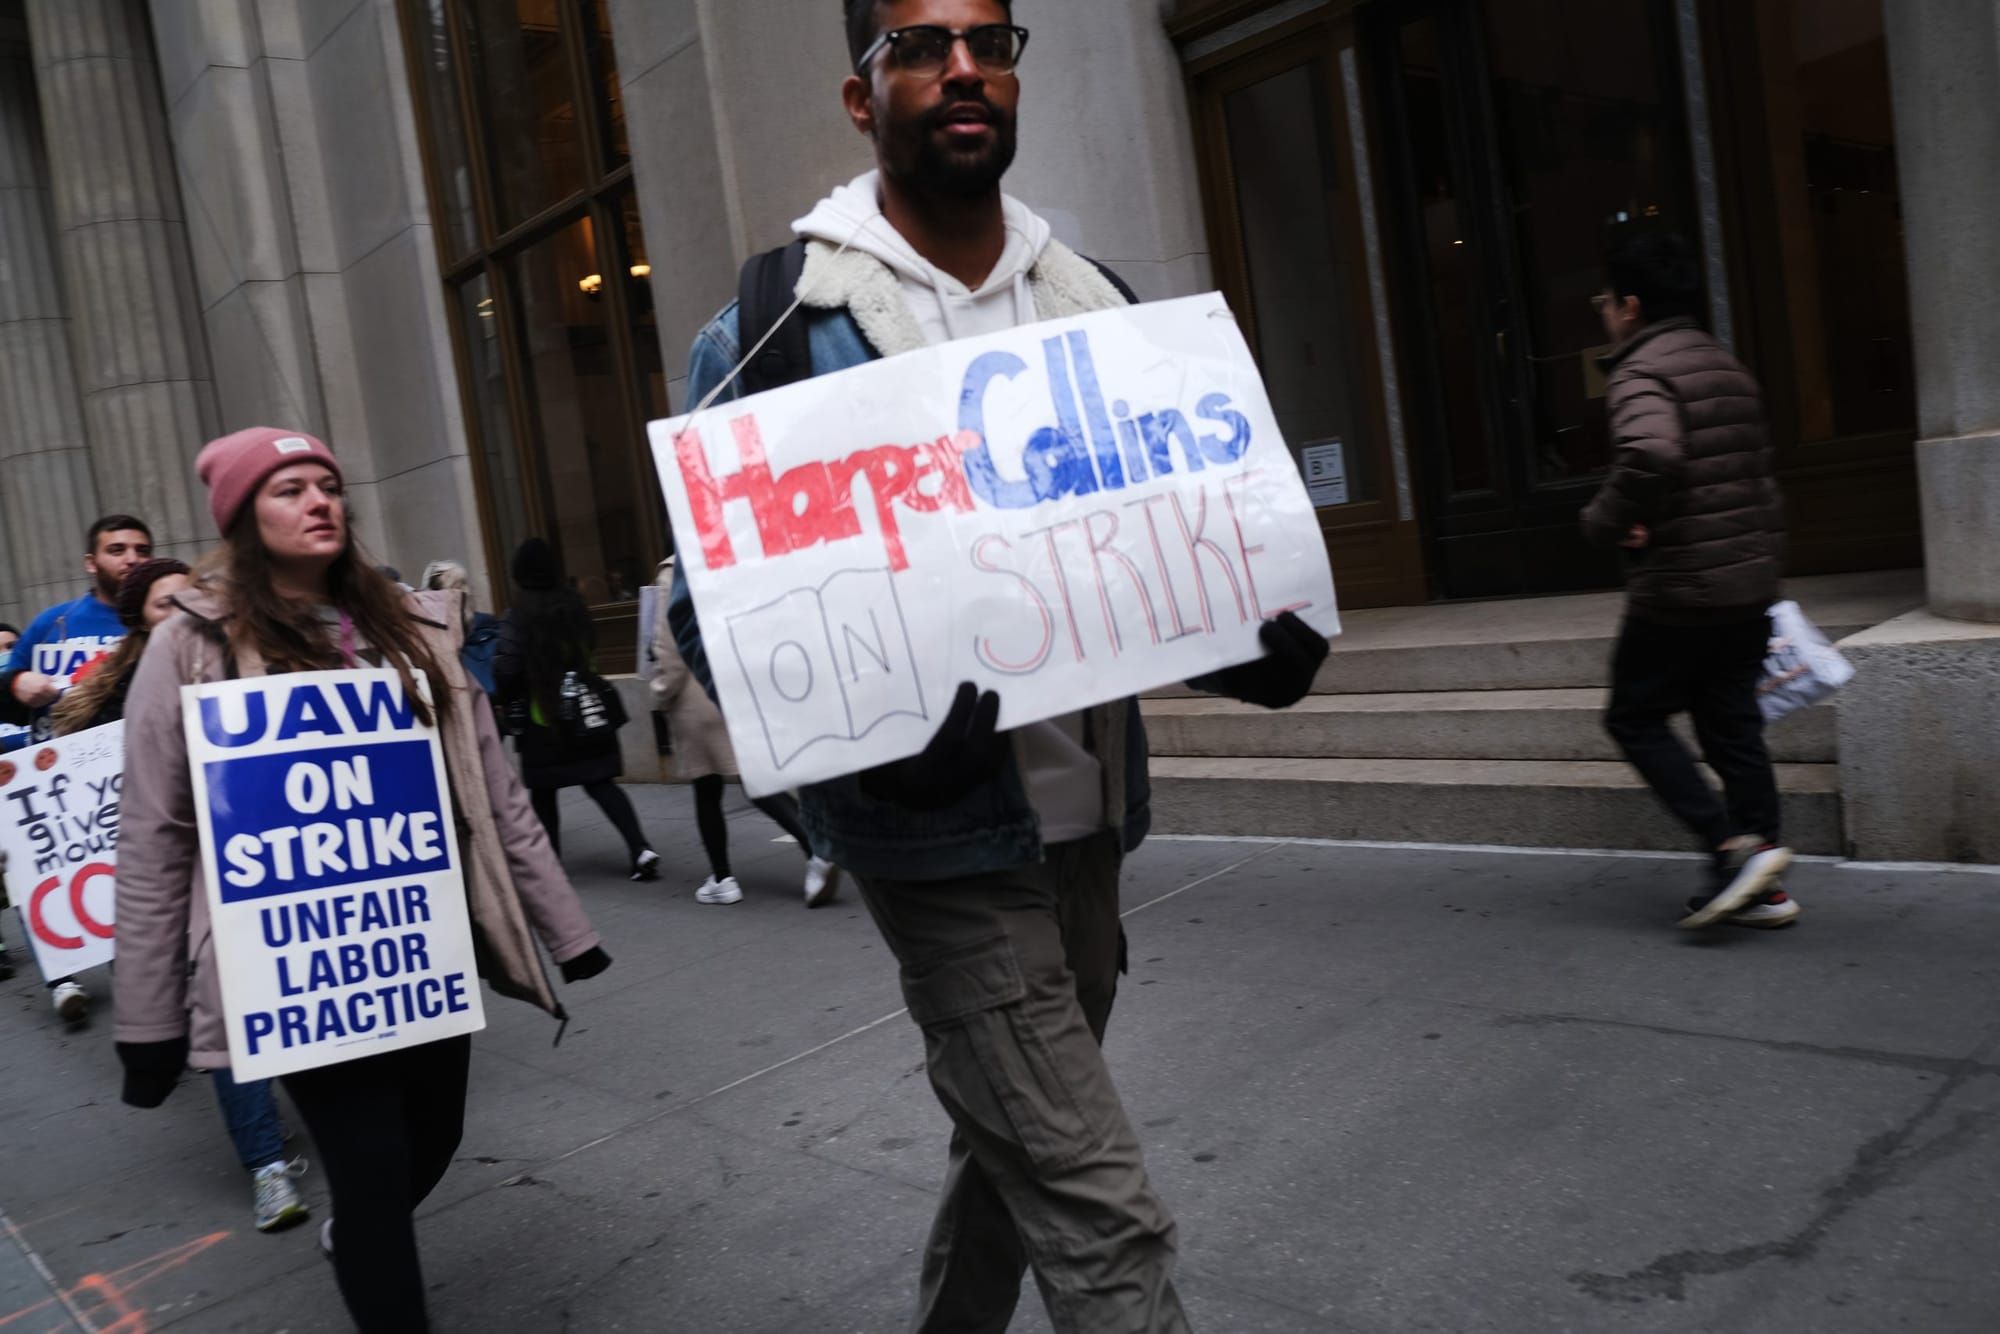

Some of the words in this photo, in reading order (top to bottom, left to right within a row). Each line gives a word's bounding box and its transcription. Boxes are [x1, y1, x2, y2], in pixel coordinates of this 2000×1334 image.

[673, 329, 1251, 573] HarperCollins
[769, 608, 891, 702] ON
[969, 469, 1313, 676] STRIKE
[39, 649, 88, 676] UA
[198, 680, 417, 748] UAW
[6, 773, 71, 827] If
[85, 771, 123, 806] yo
[284, 754, 375, 815] ON
[27, 801, 119, 855] give
[34, 828, 118, 875] mous
[223, 810, 443, 888] STRIKE
[260, 884, 431, 948] UNFAIR
[276, 932, 430, 998] LABOR
[243, 972, 470, 1056] PRACTICE
